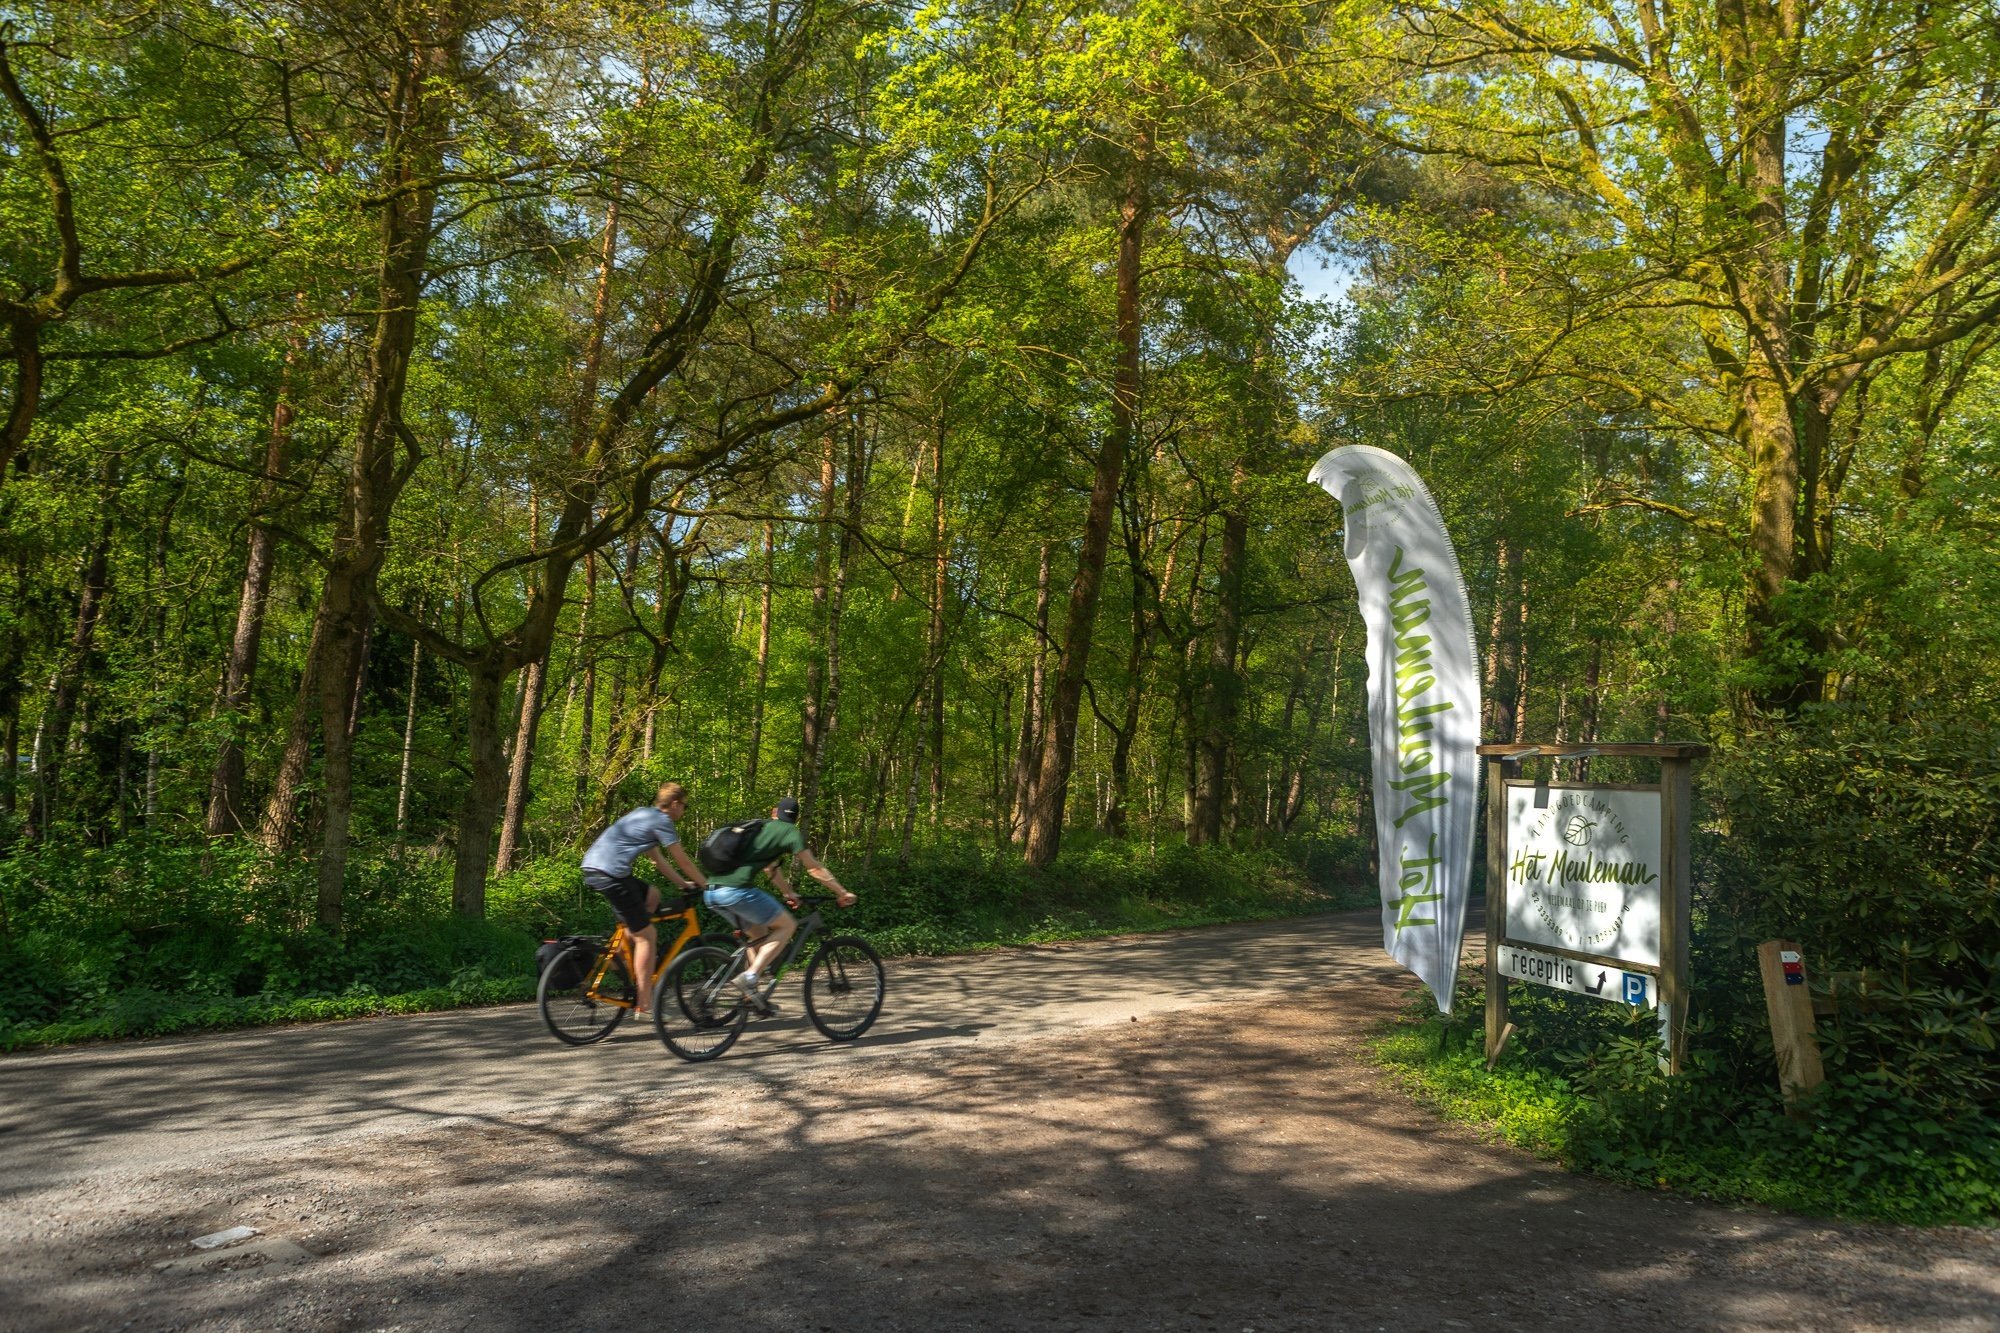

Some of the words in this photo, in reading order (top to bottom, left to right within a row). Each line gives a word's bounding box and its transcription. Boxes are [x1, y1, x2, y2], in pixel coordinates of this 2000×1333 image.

[1510, 845, 1546, 885] Het
[1547, 850, 1659, 888] Meuleman
[1511, 953, 1574, 986] receptie
[1627, 977, 1642, 1000] P
